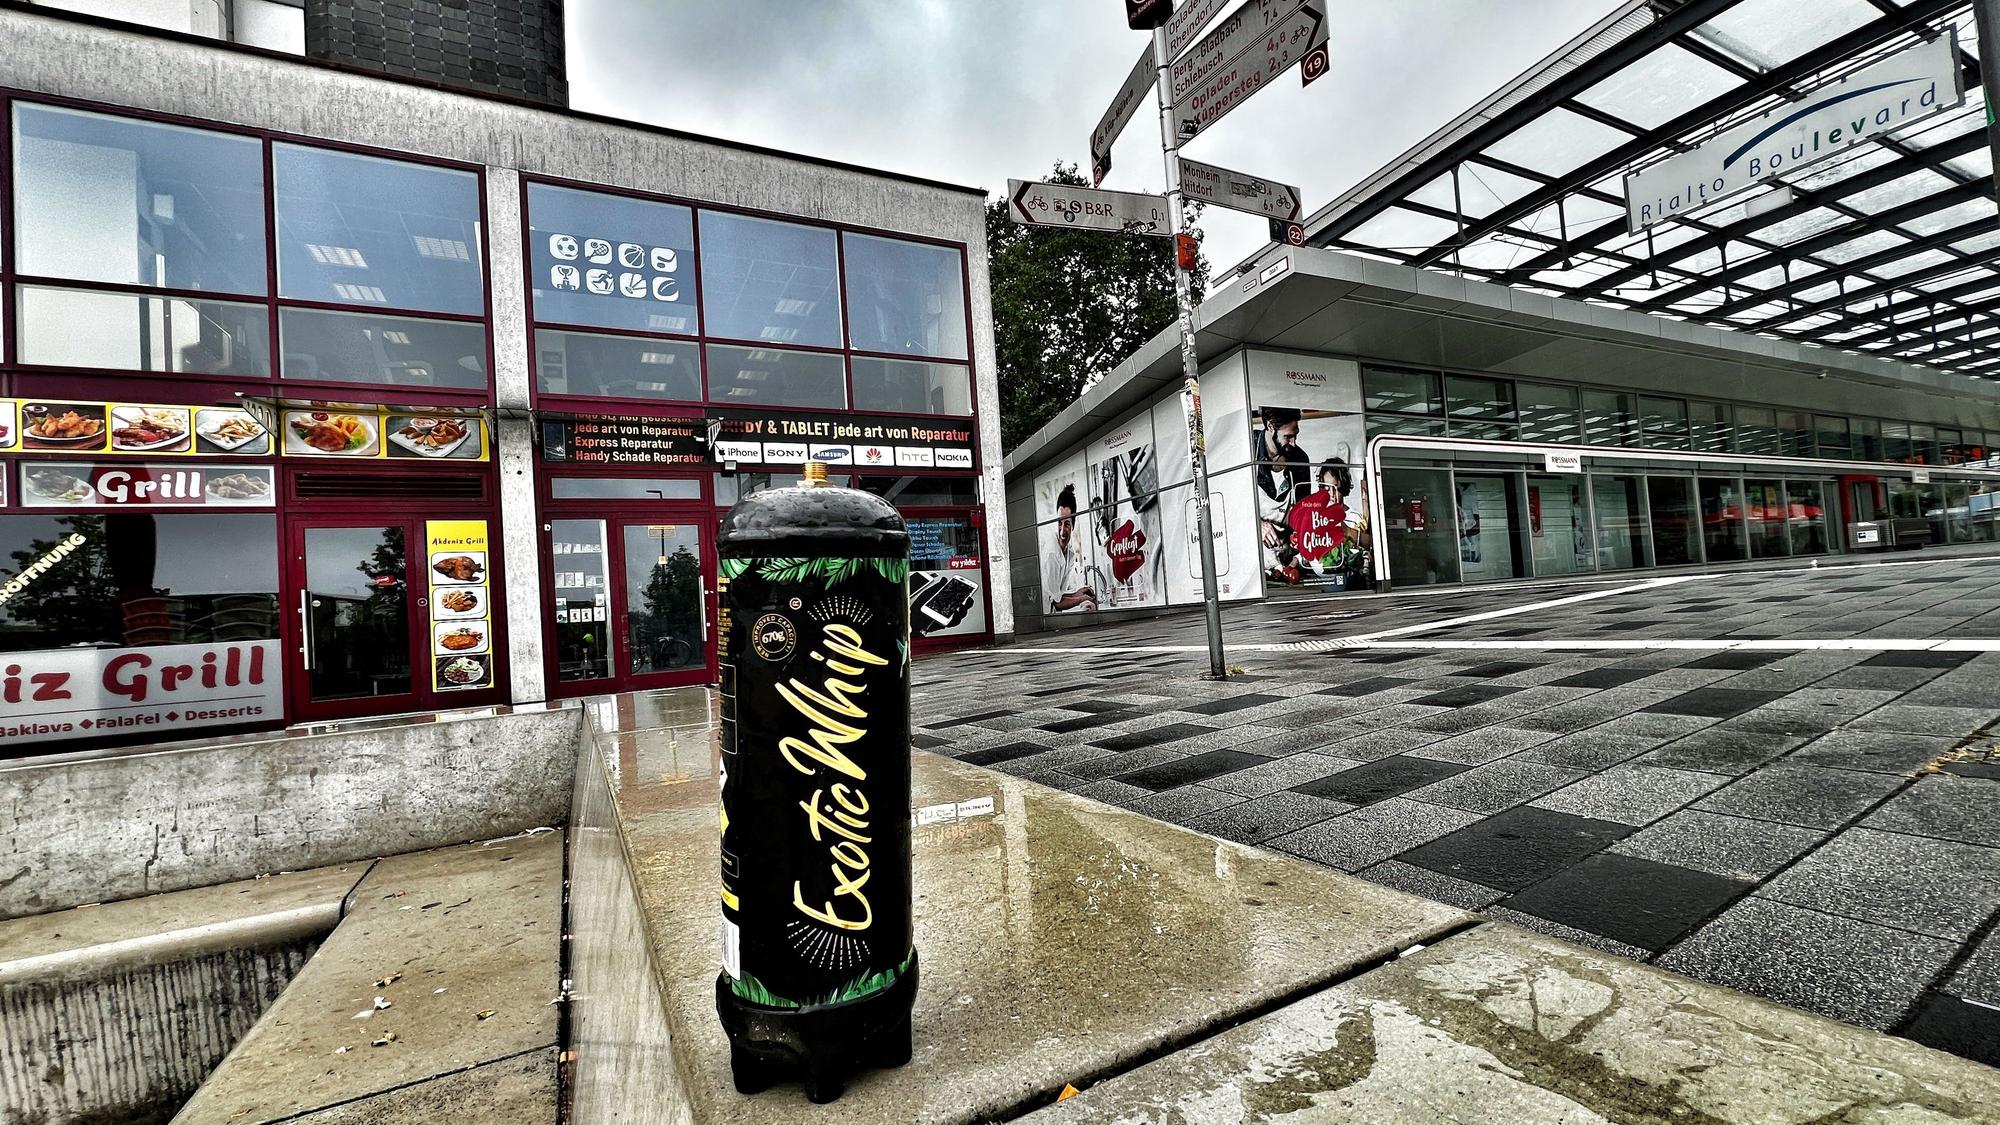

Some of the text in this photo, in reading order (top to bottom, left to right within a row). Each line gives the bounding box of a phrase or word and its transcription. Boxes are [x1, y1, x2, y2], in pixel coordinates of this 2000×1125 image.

[1168, 0, 1201, 35] Oplade
[1170, 1, 1213, 53] Rheindorf
[1175, 51, 1224, 97] Schlebusch
[1192, 31, 1286, 110] Opladen 4,8
[1307, 57, 1322, 73] 19
[1192, 50, 1289, 125] Küppersteg 2,3
[1641, 81, 1936, 222] Rialto Boulevard
[1183, 162, 1221, 184] Monheim
[1184, 179, 1213, 197] Hitdorf
[1085, 202, 1114, 217] B&R
[1290, 230, 1301, 241] 22
[1285, 370, 1327, 382] ROSSMANN
[601, 423, 618, 434] art
[620, 426, 639, 435] von
[641, 425, 694, 438] Reparatur
[766, 419, 778, 434] &
[781, 420, 830, 436] TABLET
[832, 422, 861, 439] jede
[864, 425, 884, 438] art
[886, 427, 908, 439] von
[911, 426, 970, 442] Reparatur
[575, 436, 674, 450] Express Reparatur
[727, 447, 759, 458] iPhone
[767, 449, 804, 457] SONY
[575, 450, 704, 465] Handy Schade Reparatur
[937, 453, 970, 462] NOKIA
[97, 470, 201, 504] Grill
[1312, 510, 1334, 530] Bio-
[465, 537, 484, 545] Grill
[1110, 535, 1138, 556] Gepflegt
[1303, 531, 1334, 553] Glück
[0, 532, 87, 606] RÖFFNUNG
[761, 630, 786, 644] 670g
[3, 646, 264, 703] iz Grill
[0, 705, 263, 738] Baklava Falafel Desserts
[775, 624, 889, 930] Exotic Whip
